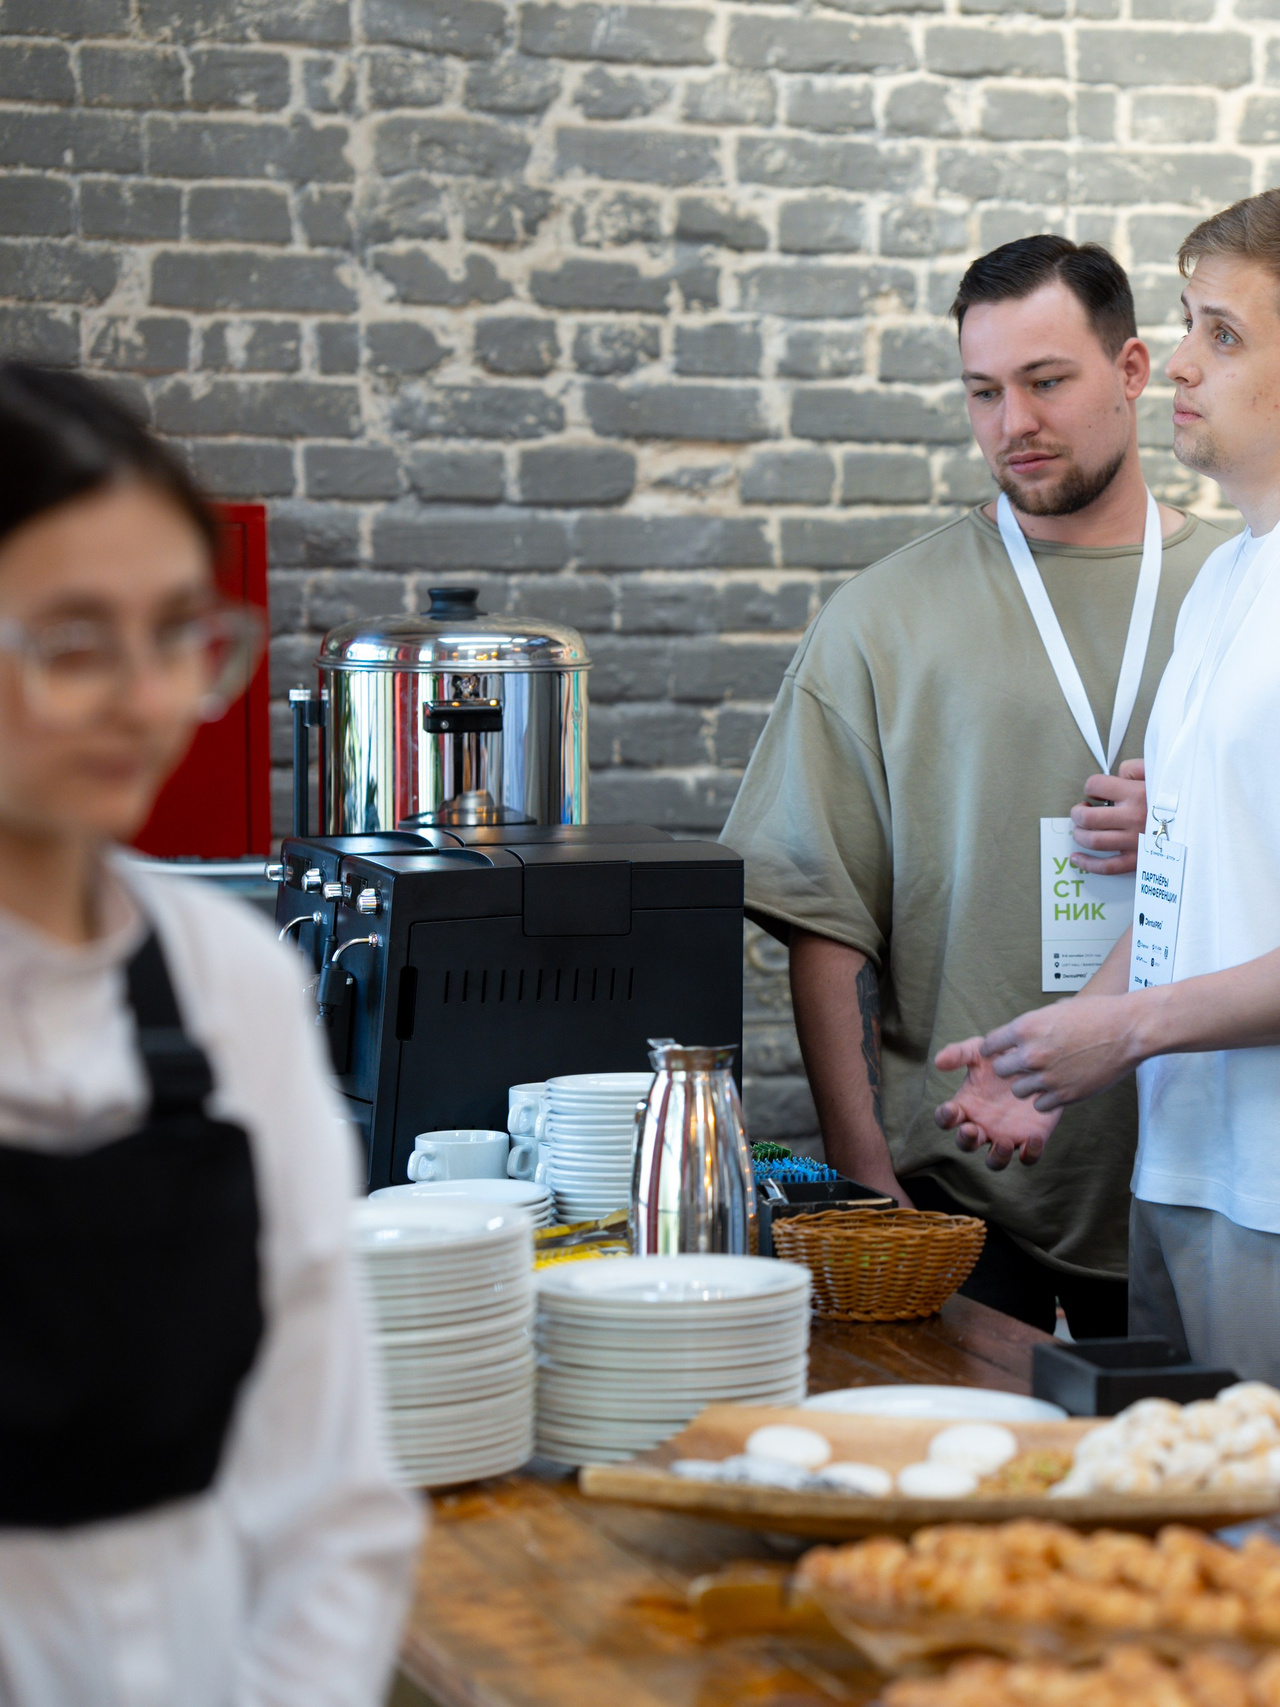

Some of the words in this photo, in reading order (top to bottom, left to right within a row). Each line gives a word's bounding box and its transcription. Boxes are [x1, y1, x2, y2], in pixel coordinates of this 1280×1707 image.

[1053, 879, 1085, 898] СТ
[1141, 870, 1170, 888] ПАРТНЁРЫ
[1140, 883, 1178, 904] КОНФЕРЕНЦИИ
[1054, 902, 1106, 921] НИК
